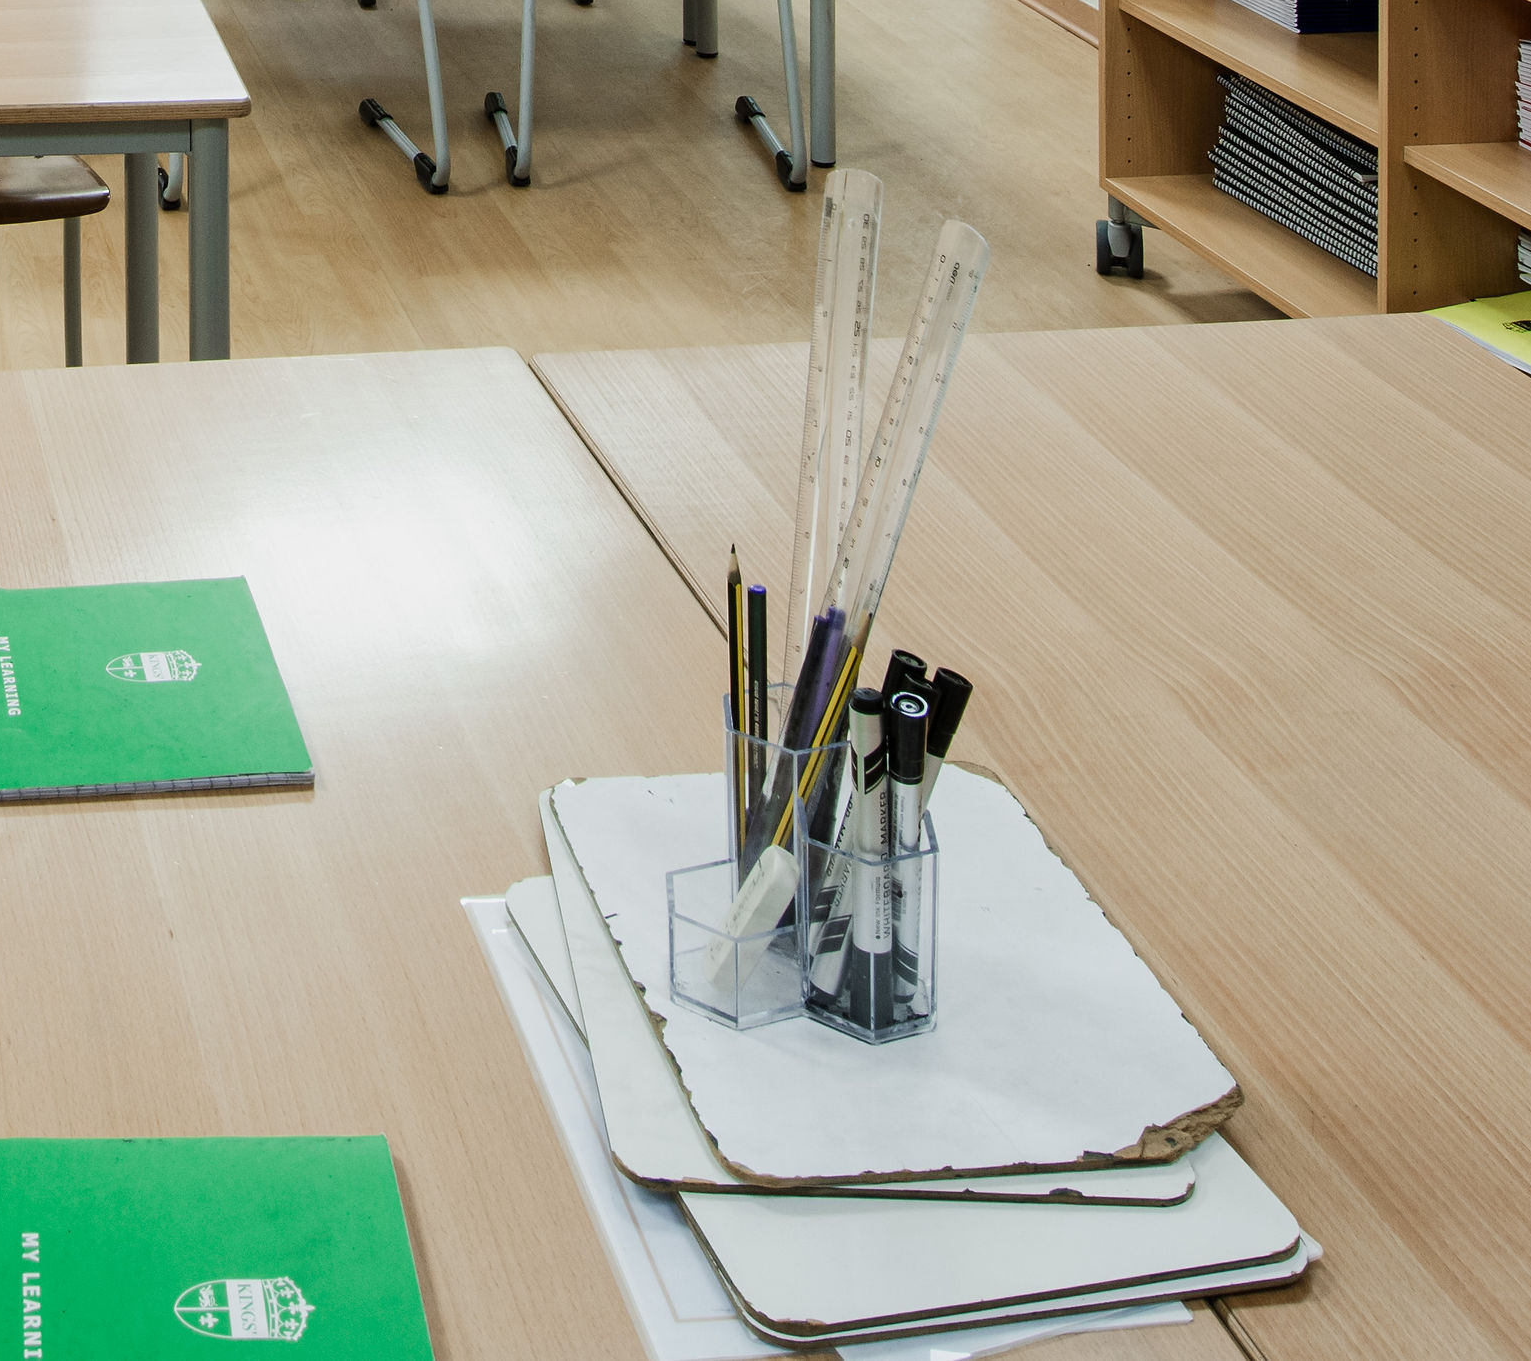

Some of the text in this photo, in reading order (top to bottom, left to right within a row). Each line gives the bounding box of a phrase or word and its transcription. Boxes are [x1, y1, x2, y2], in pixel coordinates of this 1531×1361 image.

[0, 656, 22, 717] LEARNING
[21, 1232, 39, 1263] MY
[236, 1283, 258, 1335] KINGS'
